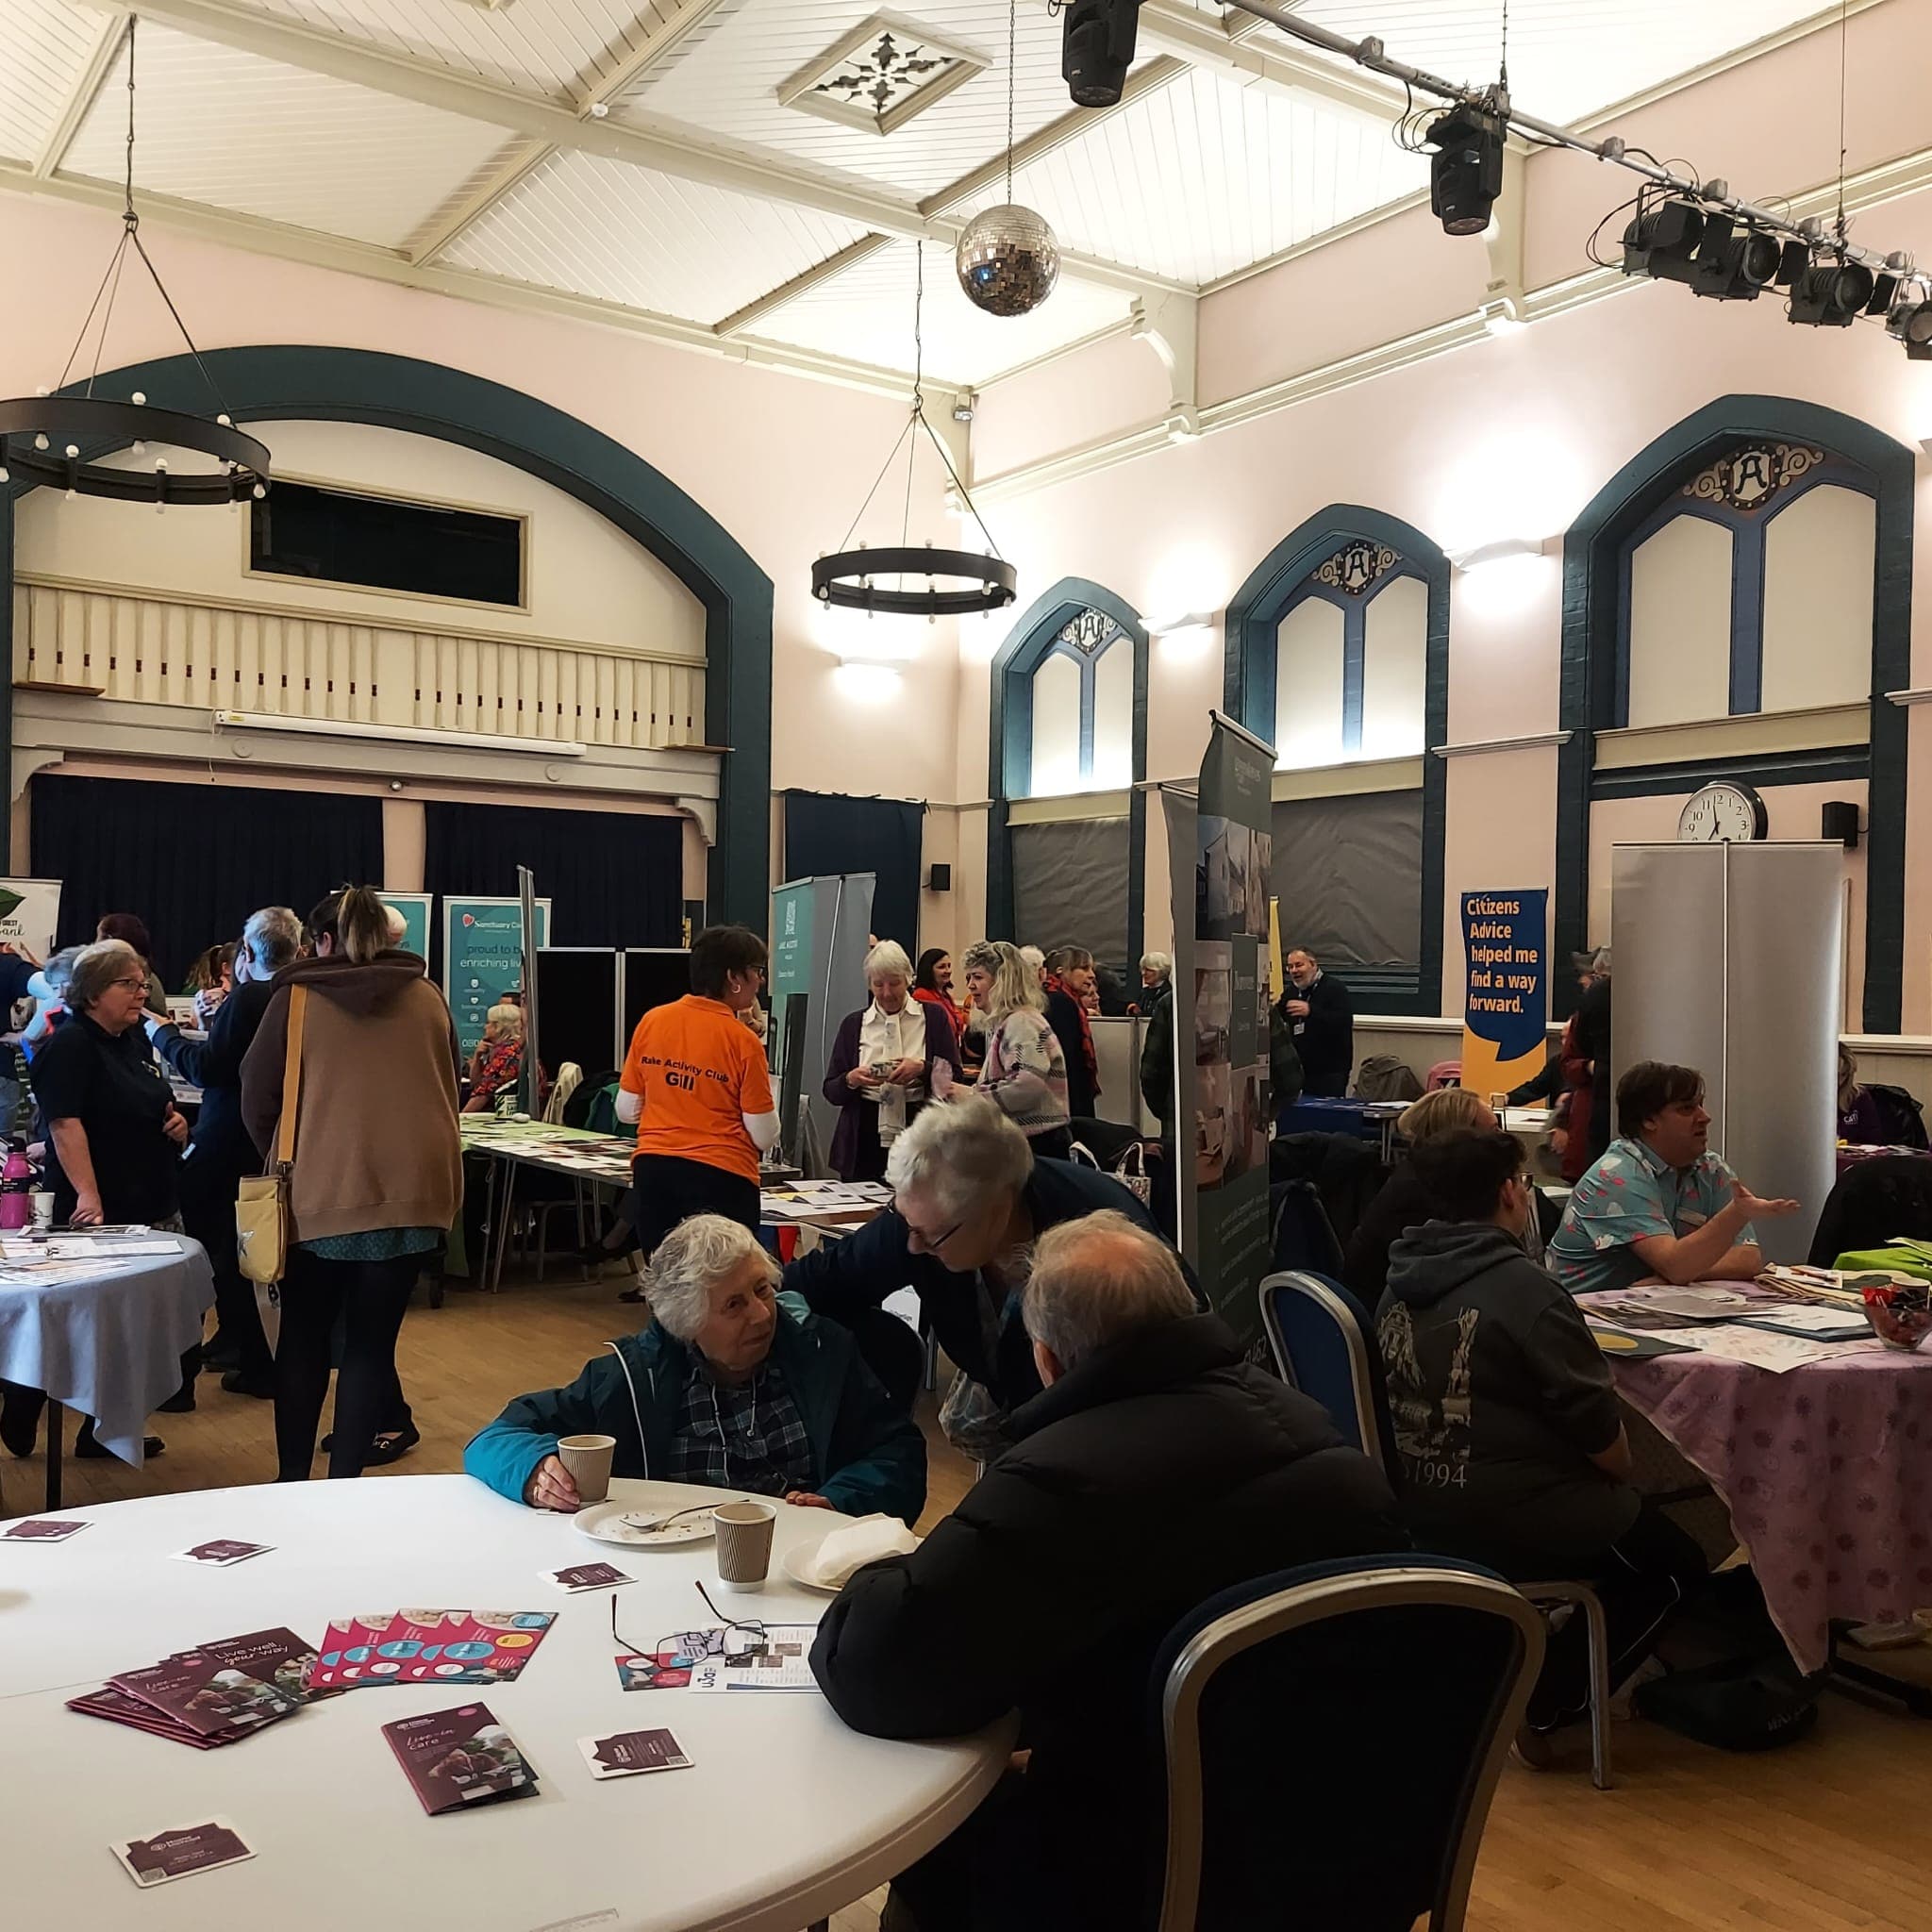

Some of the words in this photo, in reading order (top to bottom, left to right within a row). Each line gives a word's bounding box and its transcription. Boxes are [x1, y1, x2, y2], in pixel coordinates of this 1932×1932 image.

[1735, 454, 1768, 495] A
[1346, 550, 1368, 582] A
[1702, 798, 1710, 810] 11
[1736, 806, 1743, 816] 2
[1693, 810, 1704, 822] 10
[1688, 823, 1696, 832] 9
[1740, 820, 1748, 831] 3
[1467, 898, 1521, 916] Citizens
[1470, 921, 1512, 939] Advice
[468, 944, 498, 956] proud
[501, 945, 510, 954] to
[514, 944, 521, 954] b
[1472, 944, 1512, 967] helped
[1515, 948, 1538, 963] me
[460, 958, 508, 970] enriching
[510, 958, 522, 968] liv
[1471, 970, 1491, 988] find
[1494, 974, 1504, 989] a
[1508, 974, 1537, 994] way
[1470, 993, 1524, 1013] forward.
[664, 1058, 703, 1076] Activity
[705, 1069, 729, 1083] Club
[665, 1072, 695, 1091] Gill
[215, 1649, 246, 1660] Live
[225, 1653, 256, 1666] your
[258, 1645, 289, 1657] way
[409, 1739, 440, 1751] care
